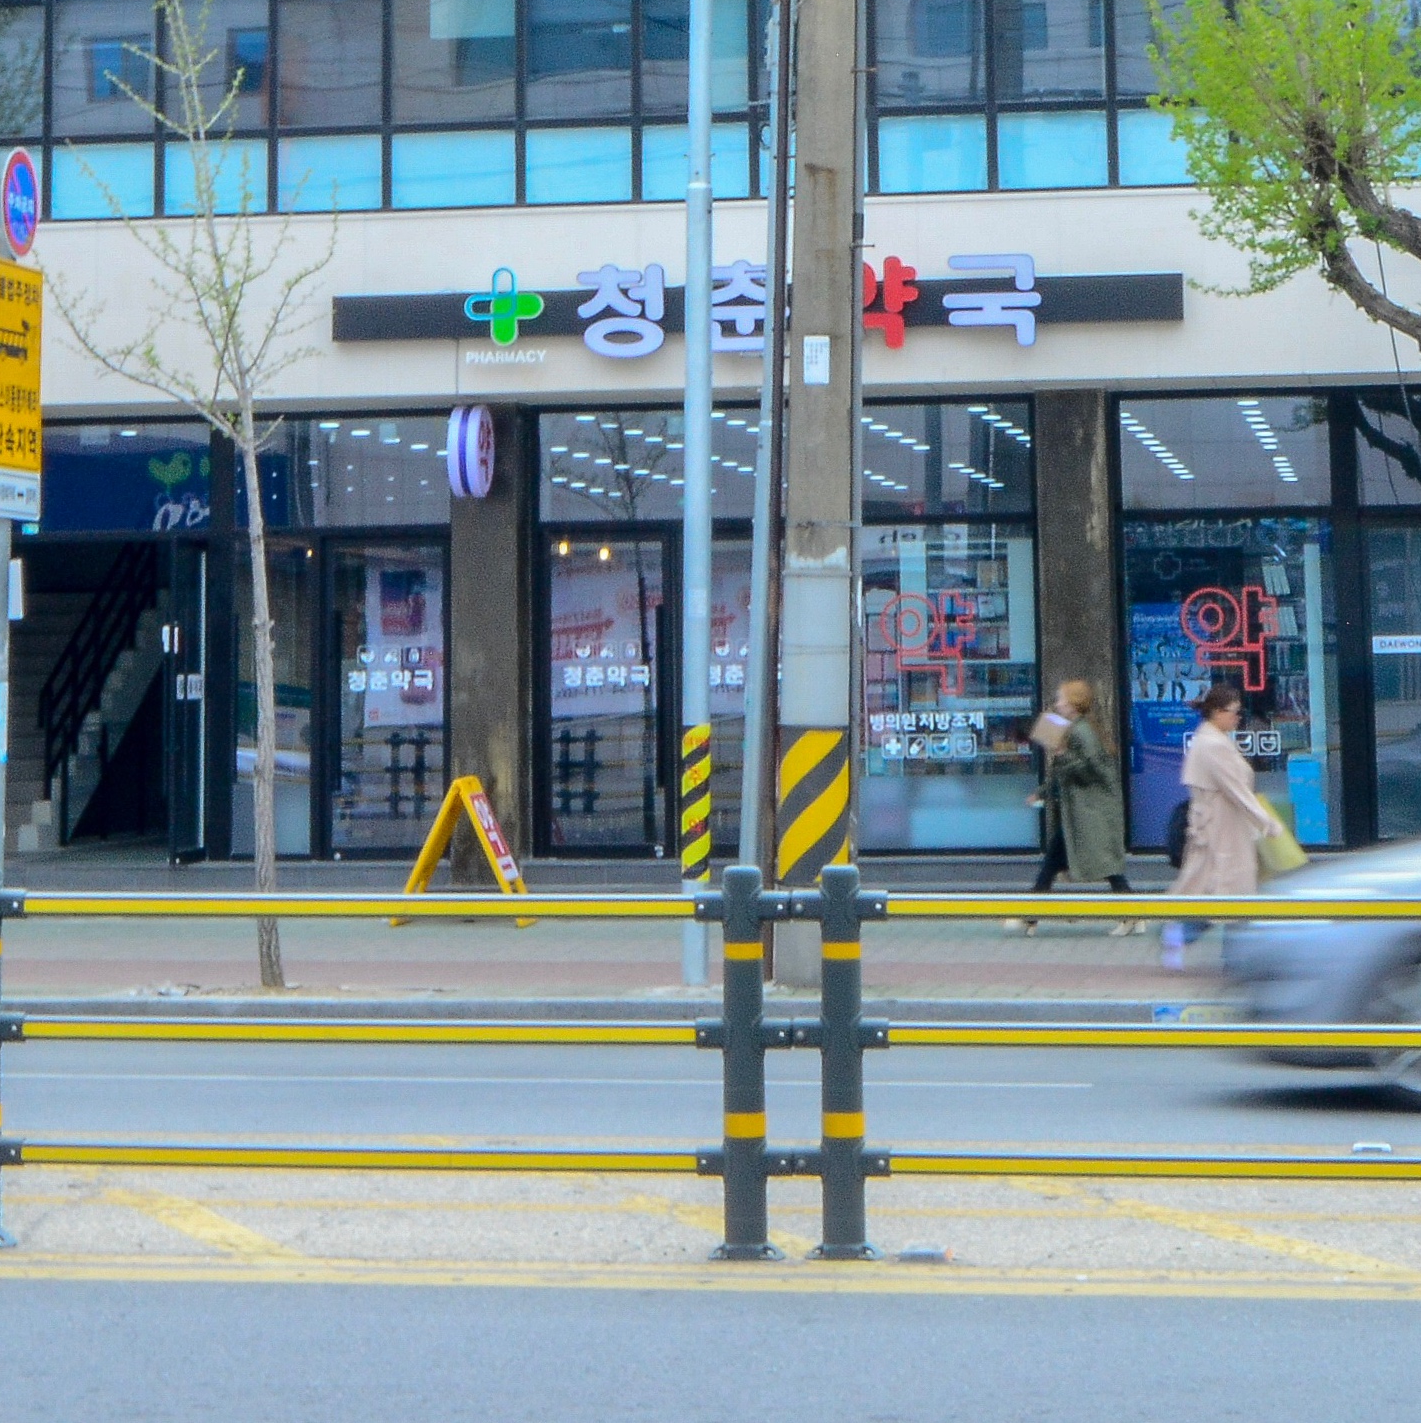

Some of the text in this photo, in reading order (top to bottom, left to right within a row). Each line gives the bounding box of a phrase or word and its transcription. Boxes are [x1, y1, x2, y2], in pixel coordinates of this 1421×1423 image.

[577, 253, 1043, 360] 청춘약국
[466, 349, 547, 365] PHARMACY
[880, 591, 977, 697] 약
[1181, 585, 1279, 692] 약
[348, 669, 434, 692] 청춘약국
[563, 664, 651, 688] 청춘약국
[870, 710, 985, 731] 병의원 처방조제
